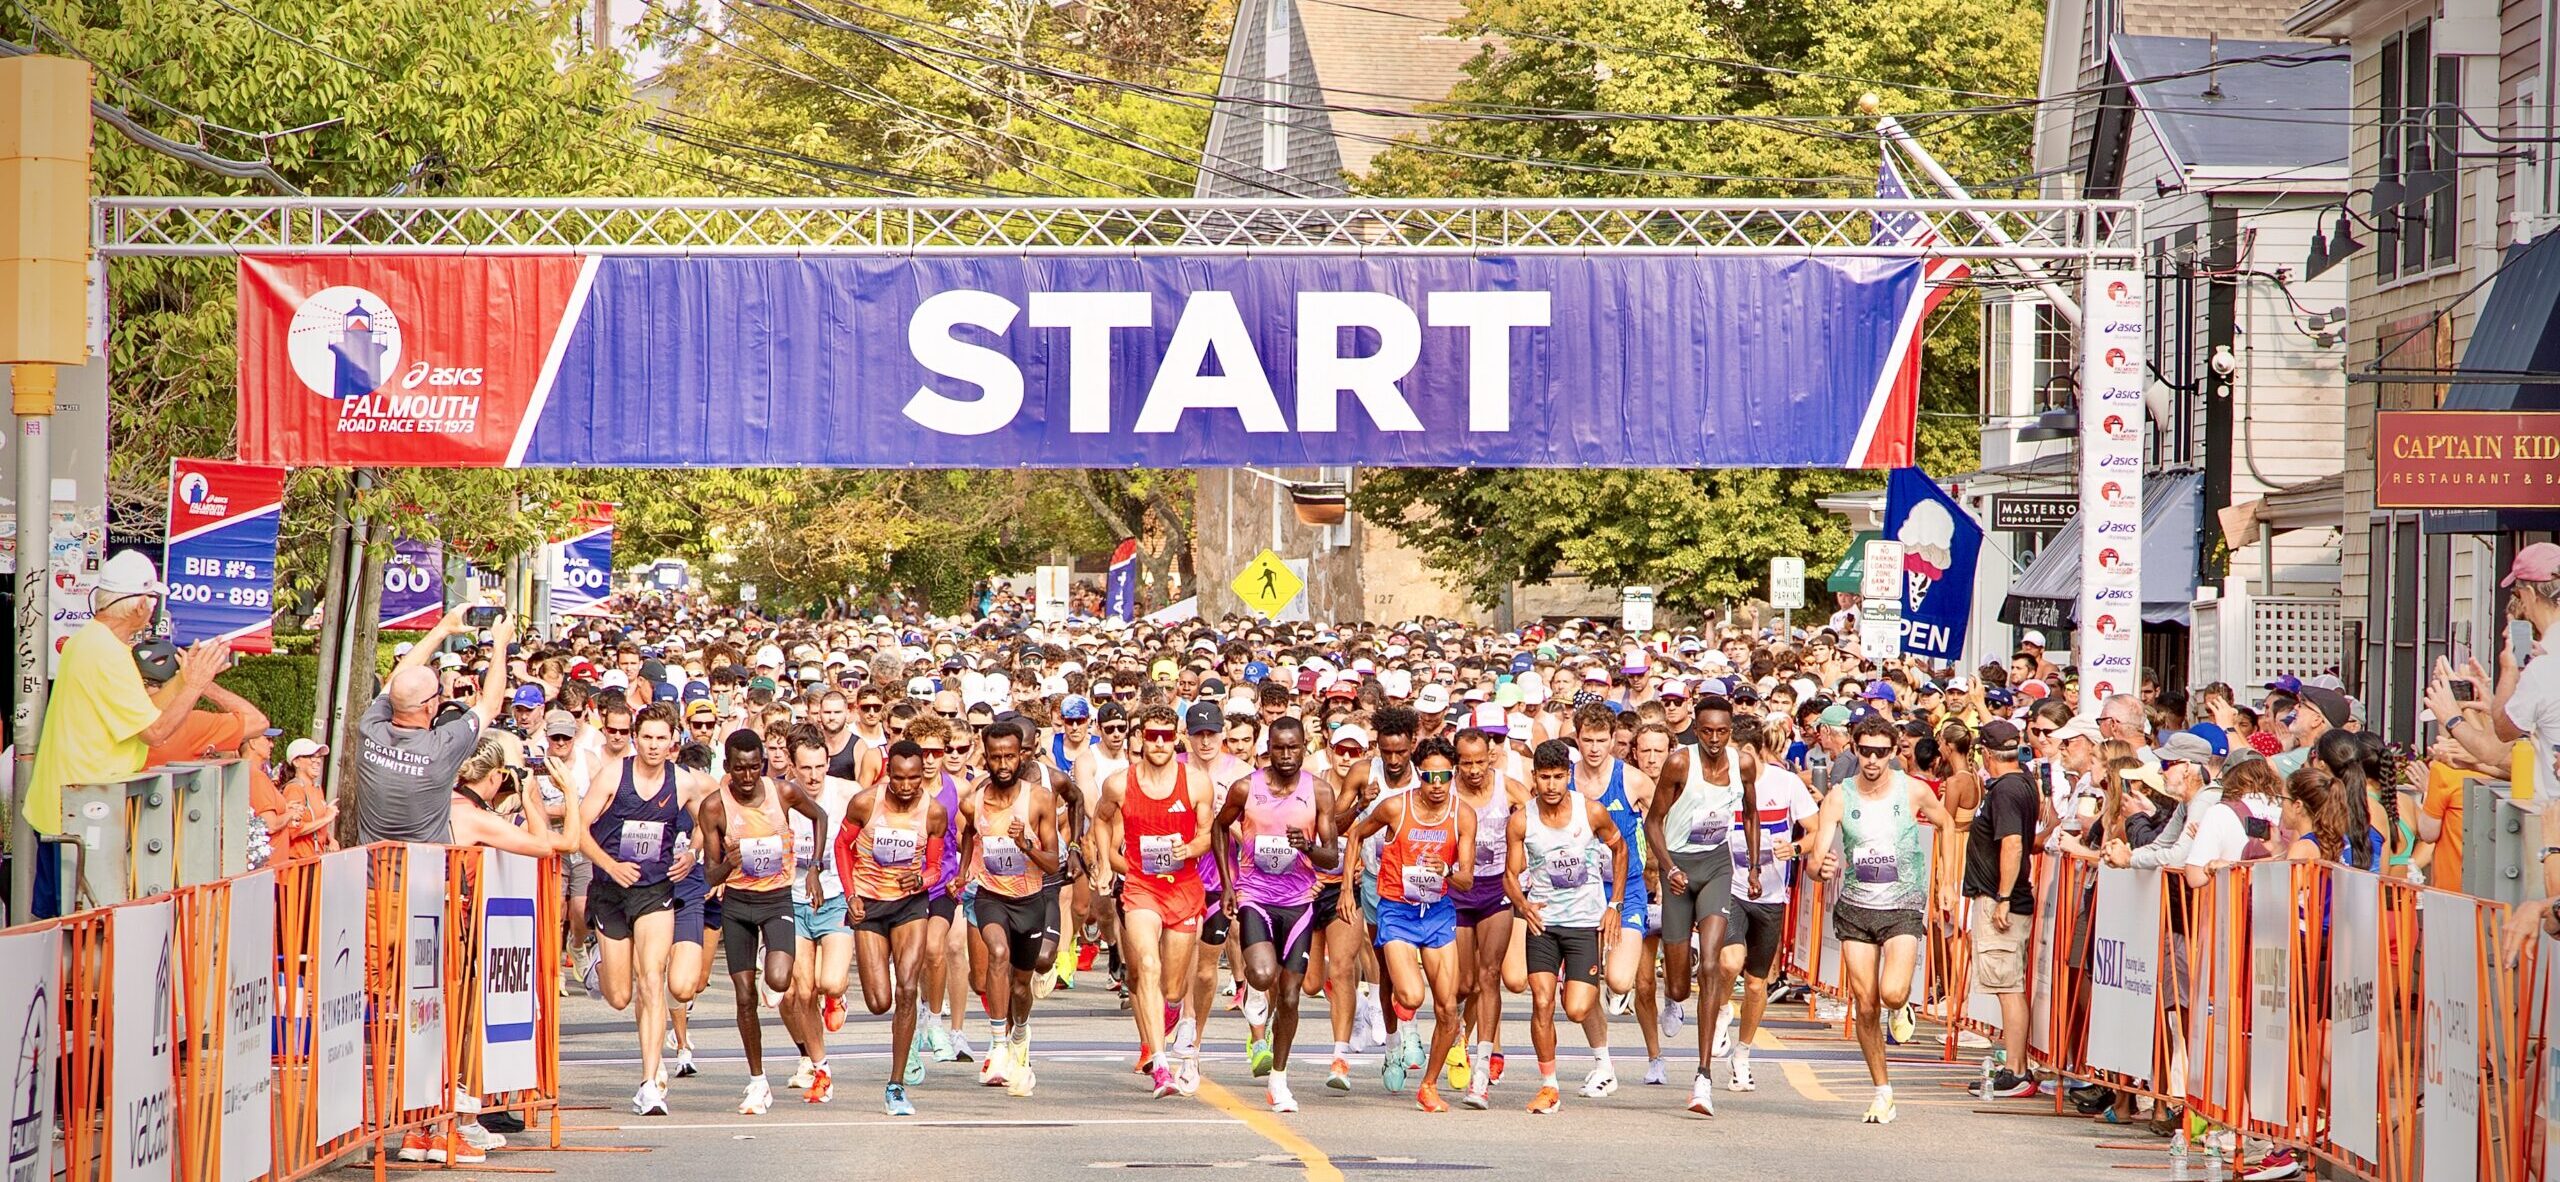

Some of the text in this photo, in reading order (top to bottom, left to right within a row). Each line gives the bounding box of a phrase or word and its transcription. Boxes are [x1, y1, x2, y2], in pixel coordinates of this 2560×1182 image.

[2117, 322, 2142, 333] asics
[901, 289, 1551, 436] START
[429, 366, 483, 387] asics
[2115, 389, 2140, 400] asics
[340, 395, 480, 419] FALMOUTH
[337, 419, 475, 433] ROAD RACE EST. 1973
[2392, 434, 2504, 460] CAPTAIN
[2113, 456, 2139, 466] asics
[2393, 473, 2510, 484] RESTAURANT
[2524, 473, 2533, 484] &
[2001, 514, 2041, 524] cape cod
[2111, 522, 2136, 533] asics
[110, 535, 165, 545] SMITH LAB
[185, 557, 256, 580] BIB #'s
[1776, 577, 1800, 588] MINUTE
[169, 583, 212, 603] 200
[229, 587, 269, 608] 899
[1374, 594, 1395, 605] 127
[1774, 591, 1801, 602] PARKING
[2108, 588, 2133, 599] asics
[66, 611, 92, 620] asics
[1900, 617, 1951, 653] PEN
[2105, 656, 2131, 666] asics
[364, 738, 430, 765] ORGANIZING
[363, 750, 425, 776] COMMITTEE
[1408, 829, 1448, 841] OKLAHOMA
[636, 841, 649, 855] 10
[876, 837, 914, 848] KIPTOO
[1259, 847, 1293, 856] KEMBOI
[755, 857, 770, 871] 22
[999, 856, 1012, 869] 14
[1156, 854, 1171, 867] 49
[1271, 856, 1279, 869] 3
[1552, 857, 1580, 868] TALBI
[1855, 855, 1896, 866] JACOBS
[1565, 868, 1574, 882] 2
[1873, 866, 1880, 878] 7
[1409, 875, 1436, 884] SILVA
[1419, 885, 1426, 897] 6
[2094, 938, 2125, 989] SBLI
[488, 946, 532, 994] PENSKE
[234, 977, 268, 1035] PREMIER
[322, 990, 362, 1032] FLYING BRIDGE
